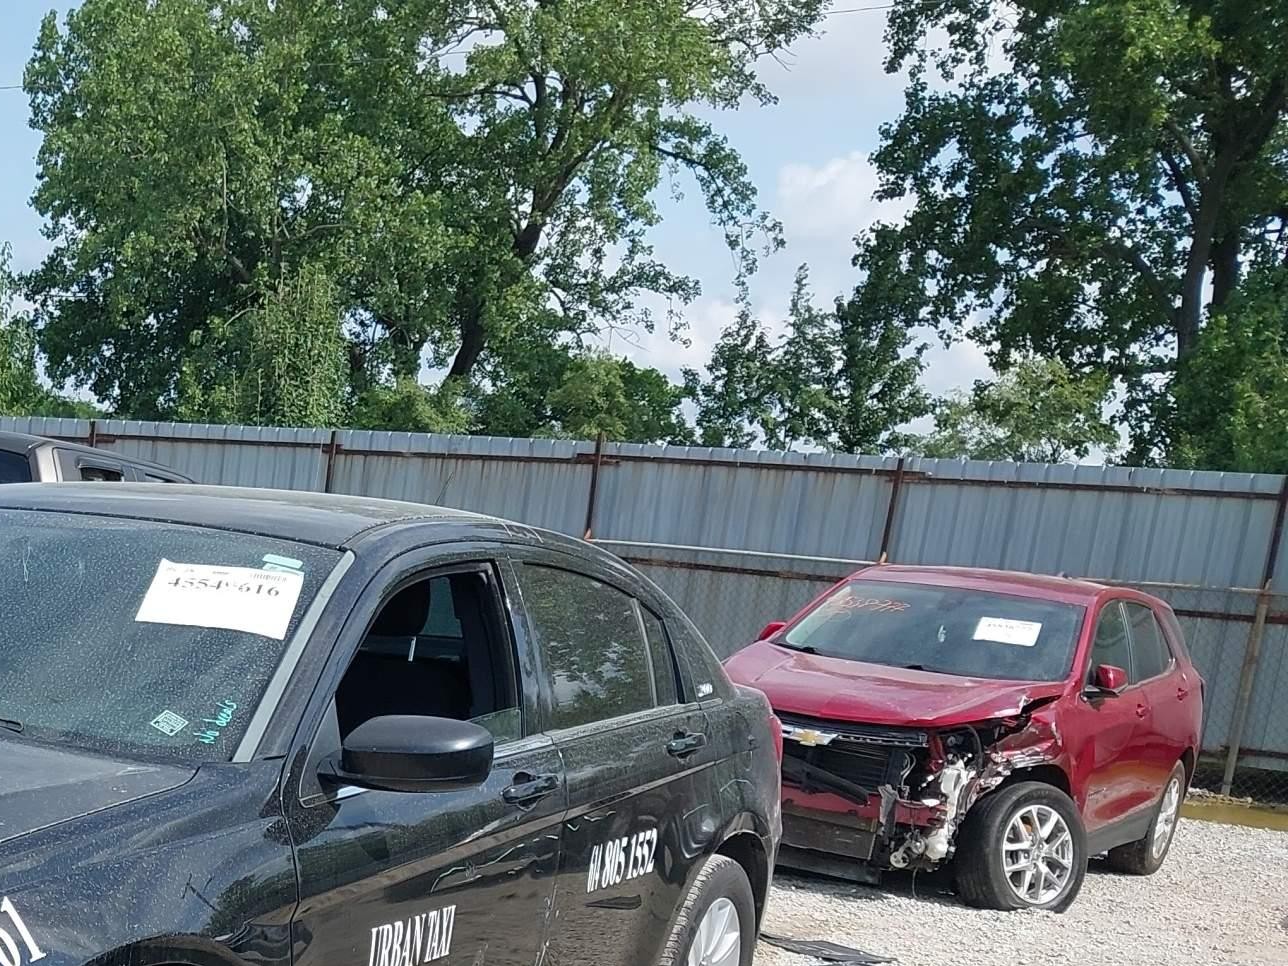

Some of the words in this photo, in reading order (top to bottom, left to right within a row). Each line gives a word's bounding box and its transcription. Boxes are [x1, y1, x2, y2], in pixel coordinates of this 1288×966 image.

[601, 836, 629, 888] 805
[625, 827, 658, 880] 1552
[423, 905, 457, 963] TAXI
